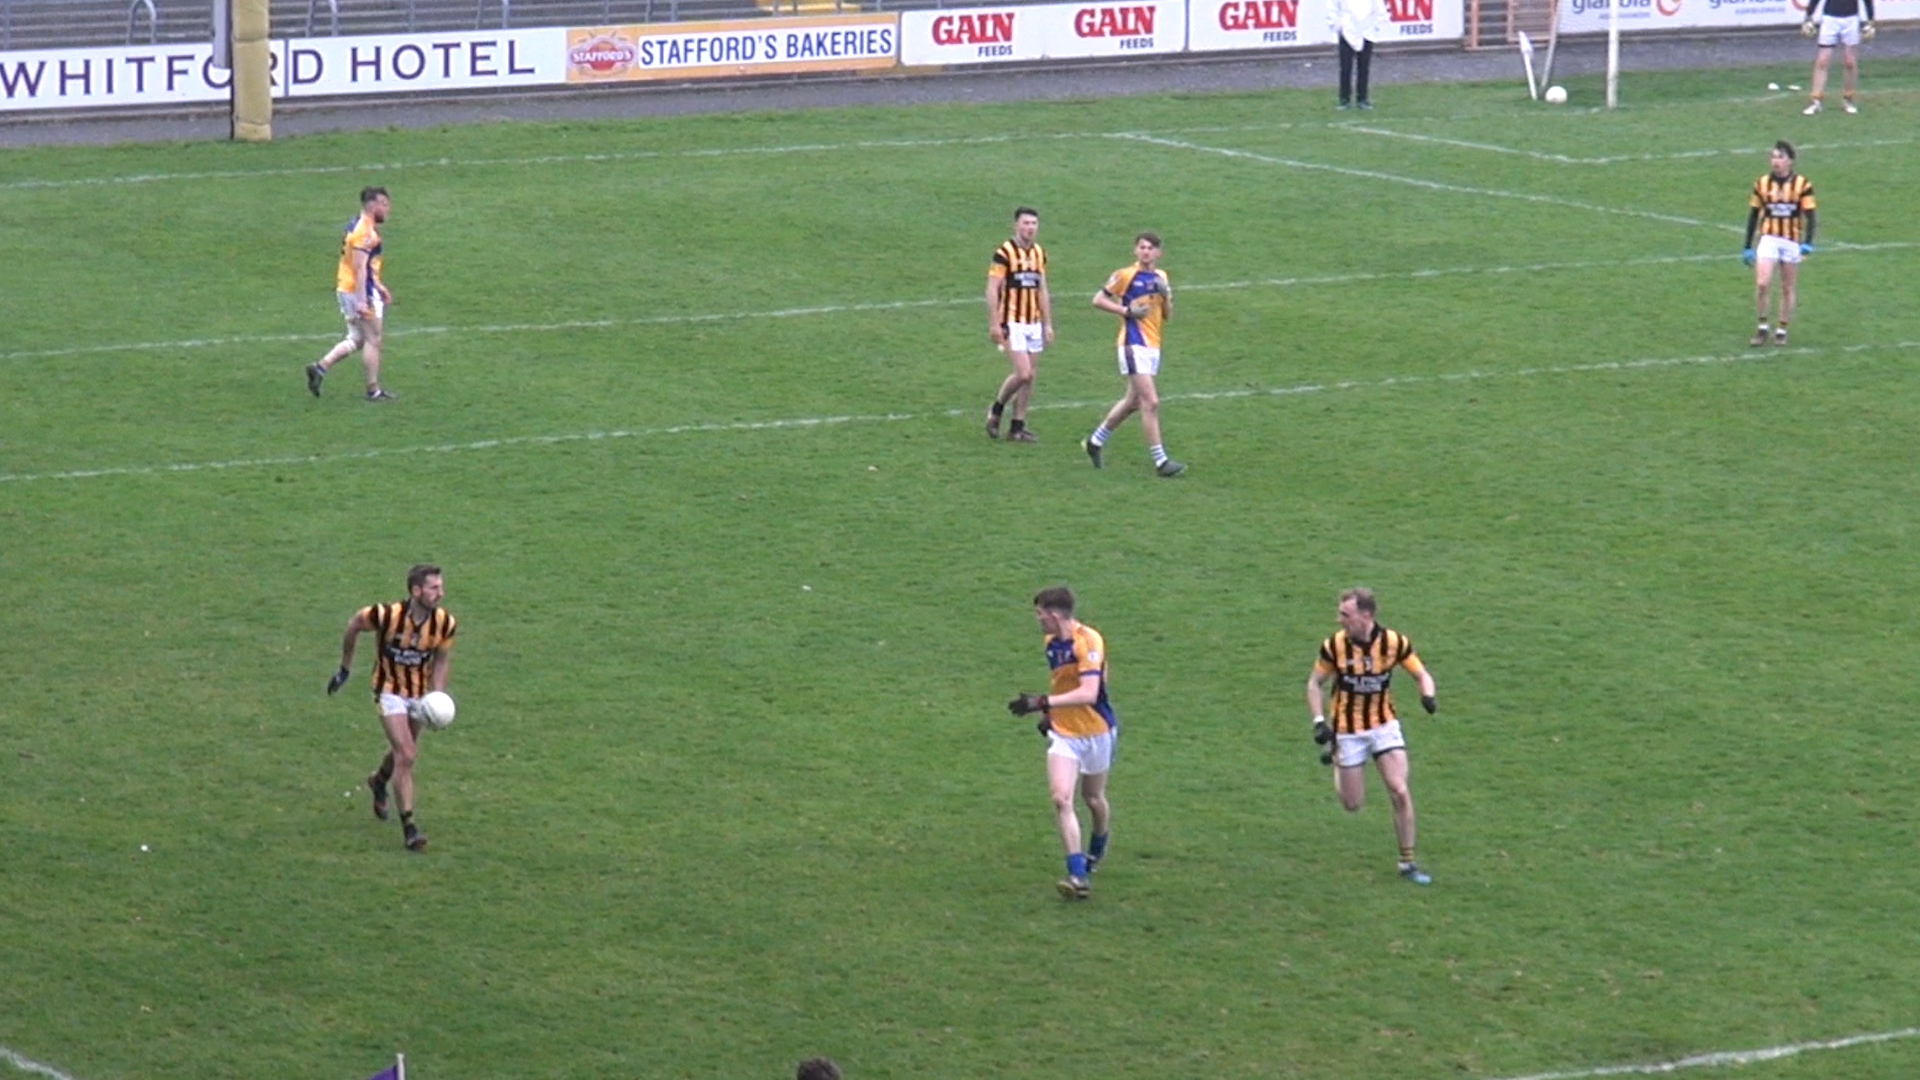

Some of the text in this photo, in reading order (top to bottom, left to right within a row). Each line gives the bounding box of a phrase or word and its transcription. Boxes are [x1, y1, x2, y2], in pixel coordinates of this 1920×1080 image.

[931, 13, 1015, 45] GAIN
[1074, 6, 1156, 38] GAIN
[1219, 0, 1298, 31] GAIN
[1400, 23, 1433, 35] FEEDS
[641, 28, 893, 66] STAFFORD'S BAKERIES
[977, 45, 1013, 57] FEEDS
[1120, 38, 1154, 49] FEEDS
[1263, 31, 1297, 42] FEEDS
[351, 40, 535, 82] HOTEL
